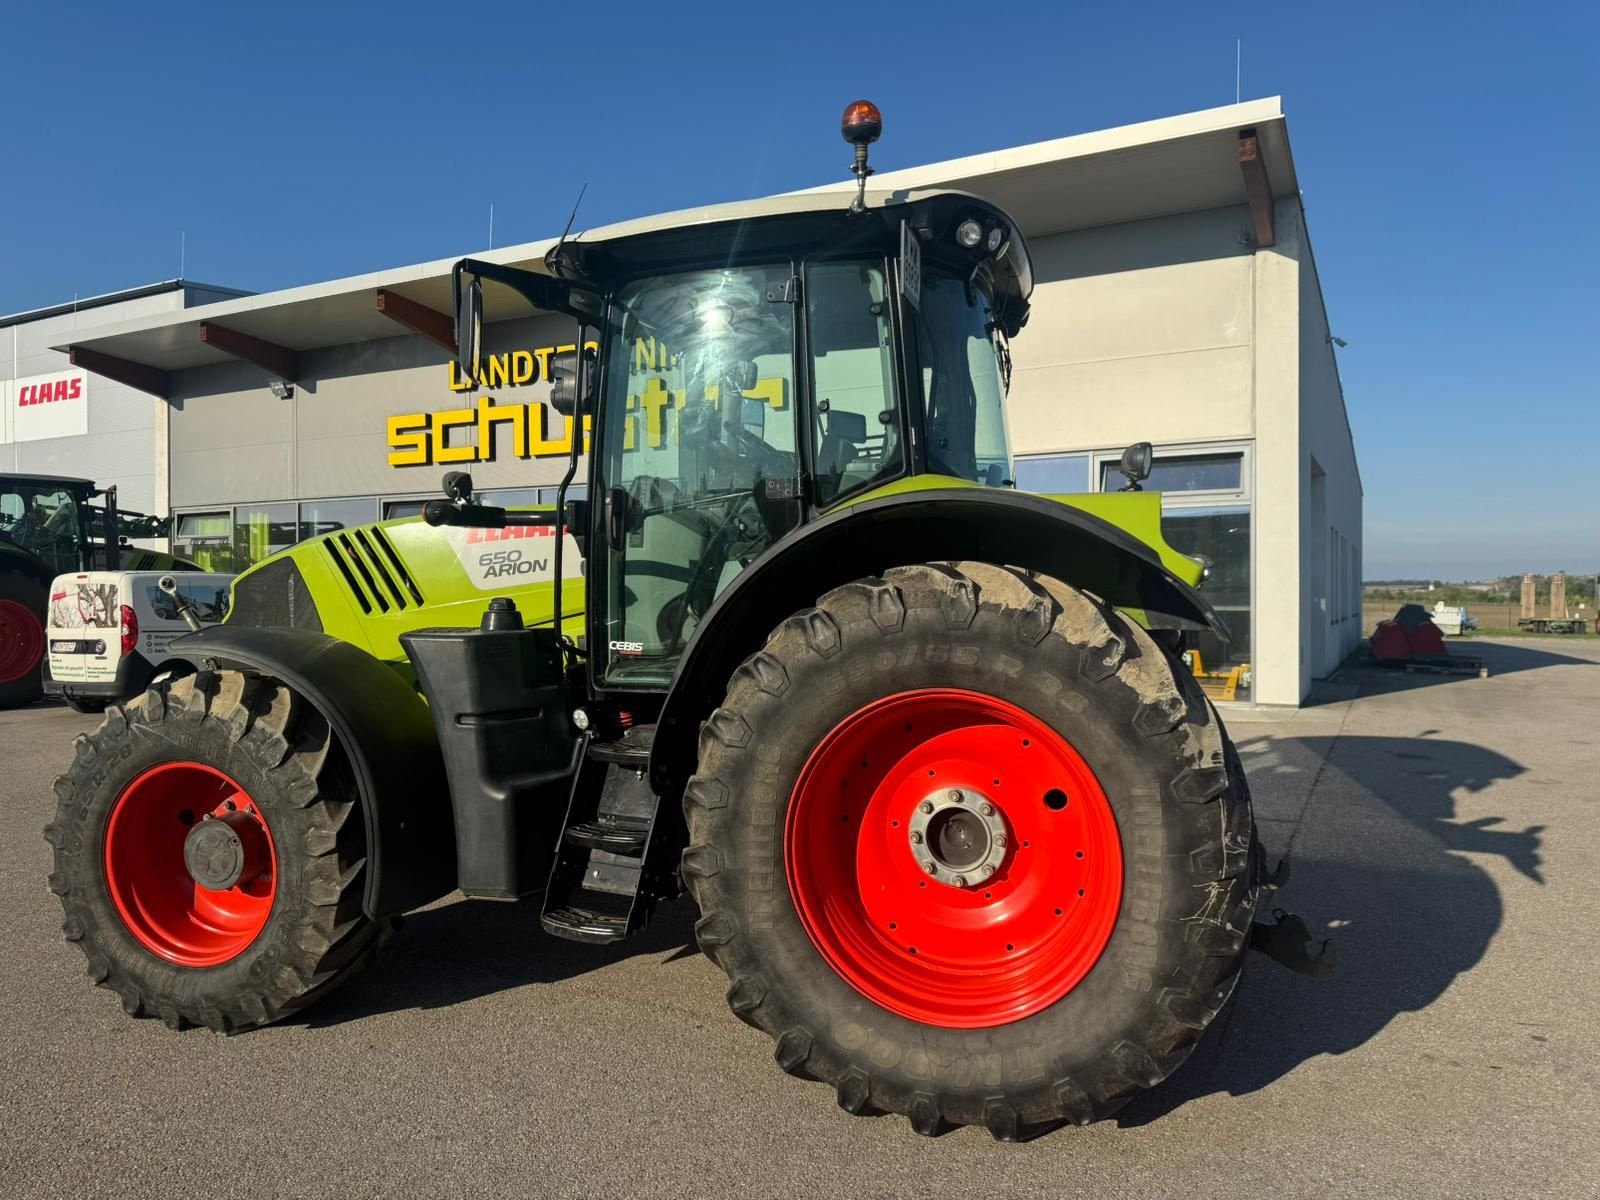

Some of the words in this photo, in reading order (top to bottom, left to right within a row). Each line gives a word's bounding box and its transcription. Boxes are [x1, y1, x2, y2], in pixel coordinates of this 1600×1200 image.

[19, 377, 82, 407] CLAAS
[479, 549, 522, 567] 650
[483, 558, 548, 579] ARION
[608, 640, 644, 652] CEBIS
[746, 743, 782, 935] TRELLEBORG
